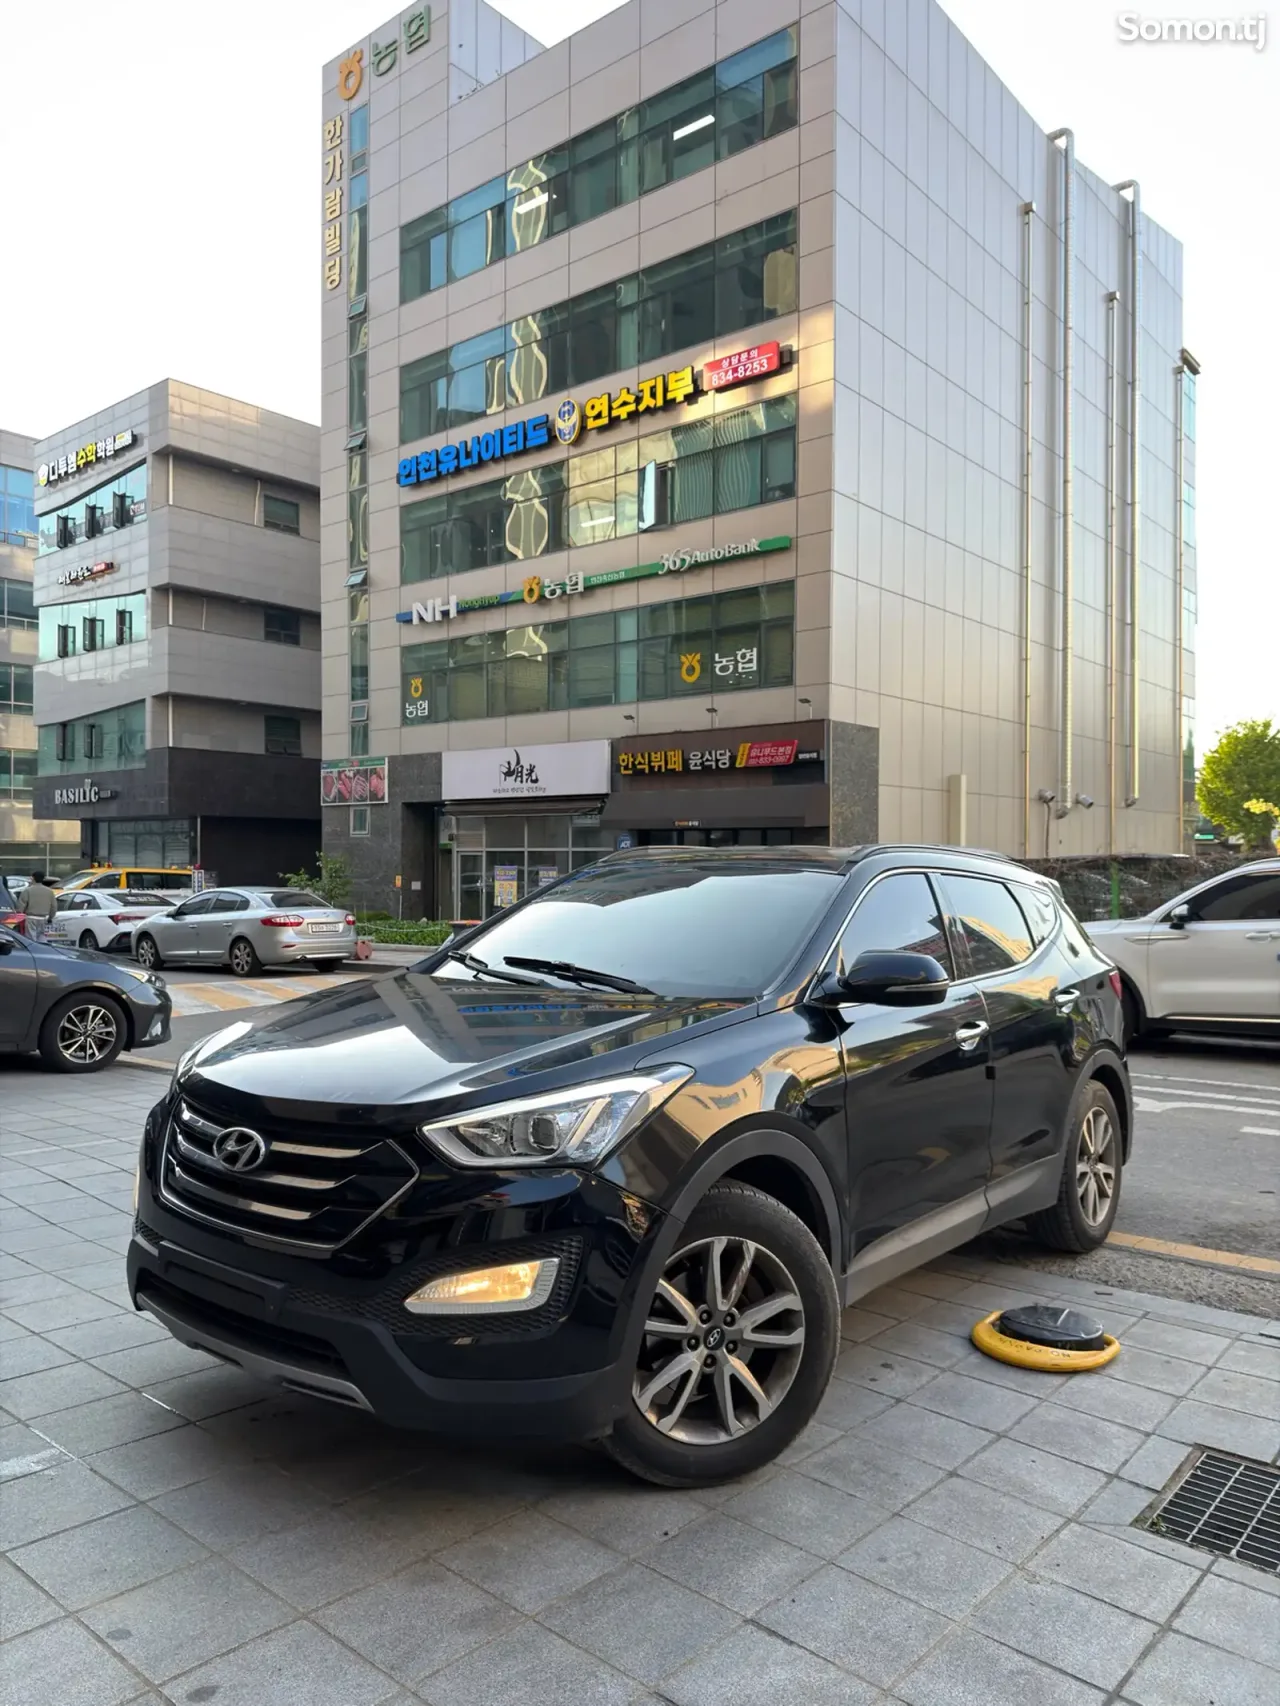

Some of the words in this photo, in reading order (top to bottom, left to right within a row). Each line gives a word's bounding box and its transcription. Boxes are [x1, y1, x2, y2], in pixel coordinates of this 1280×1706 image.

[371, 5, 431, 77] 농협
[323, 114, 343, 291] 한가람빌딩
[711, 358, 768, 386] 834-8253
[721, 348, 758, 369] 상담문의
[397, 413, 549, 488] 인천유나이티드
[584, 364, 694, 431] 연수지부
[411, 595, 458, 625] NH
[543, 571, 584, 600] 농협
[713, 647, 757, 676] 농협
[405, 700, 428, 718] 농협
[618, 749, 682, 775] 한식뷔페
[688, 749, 731, 770] 윤식당
[54, 780, 99, 804] BASILIC
